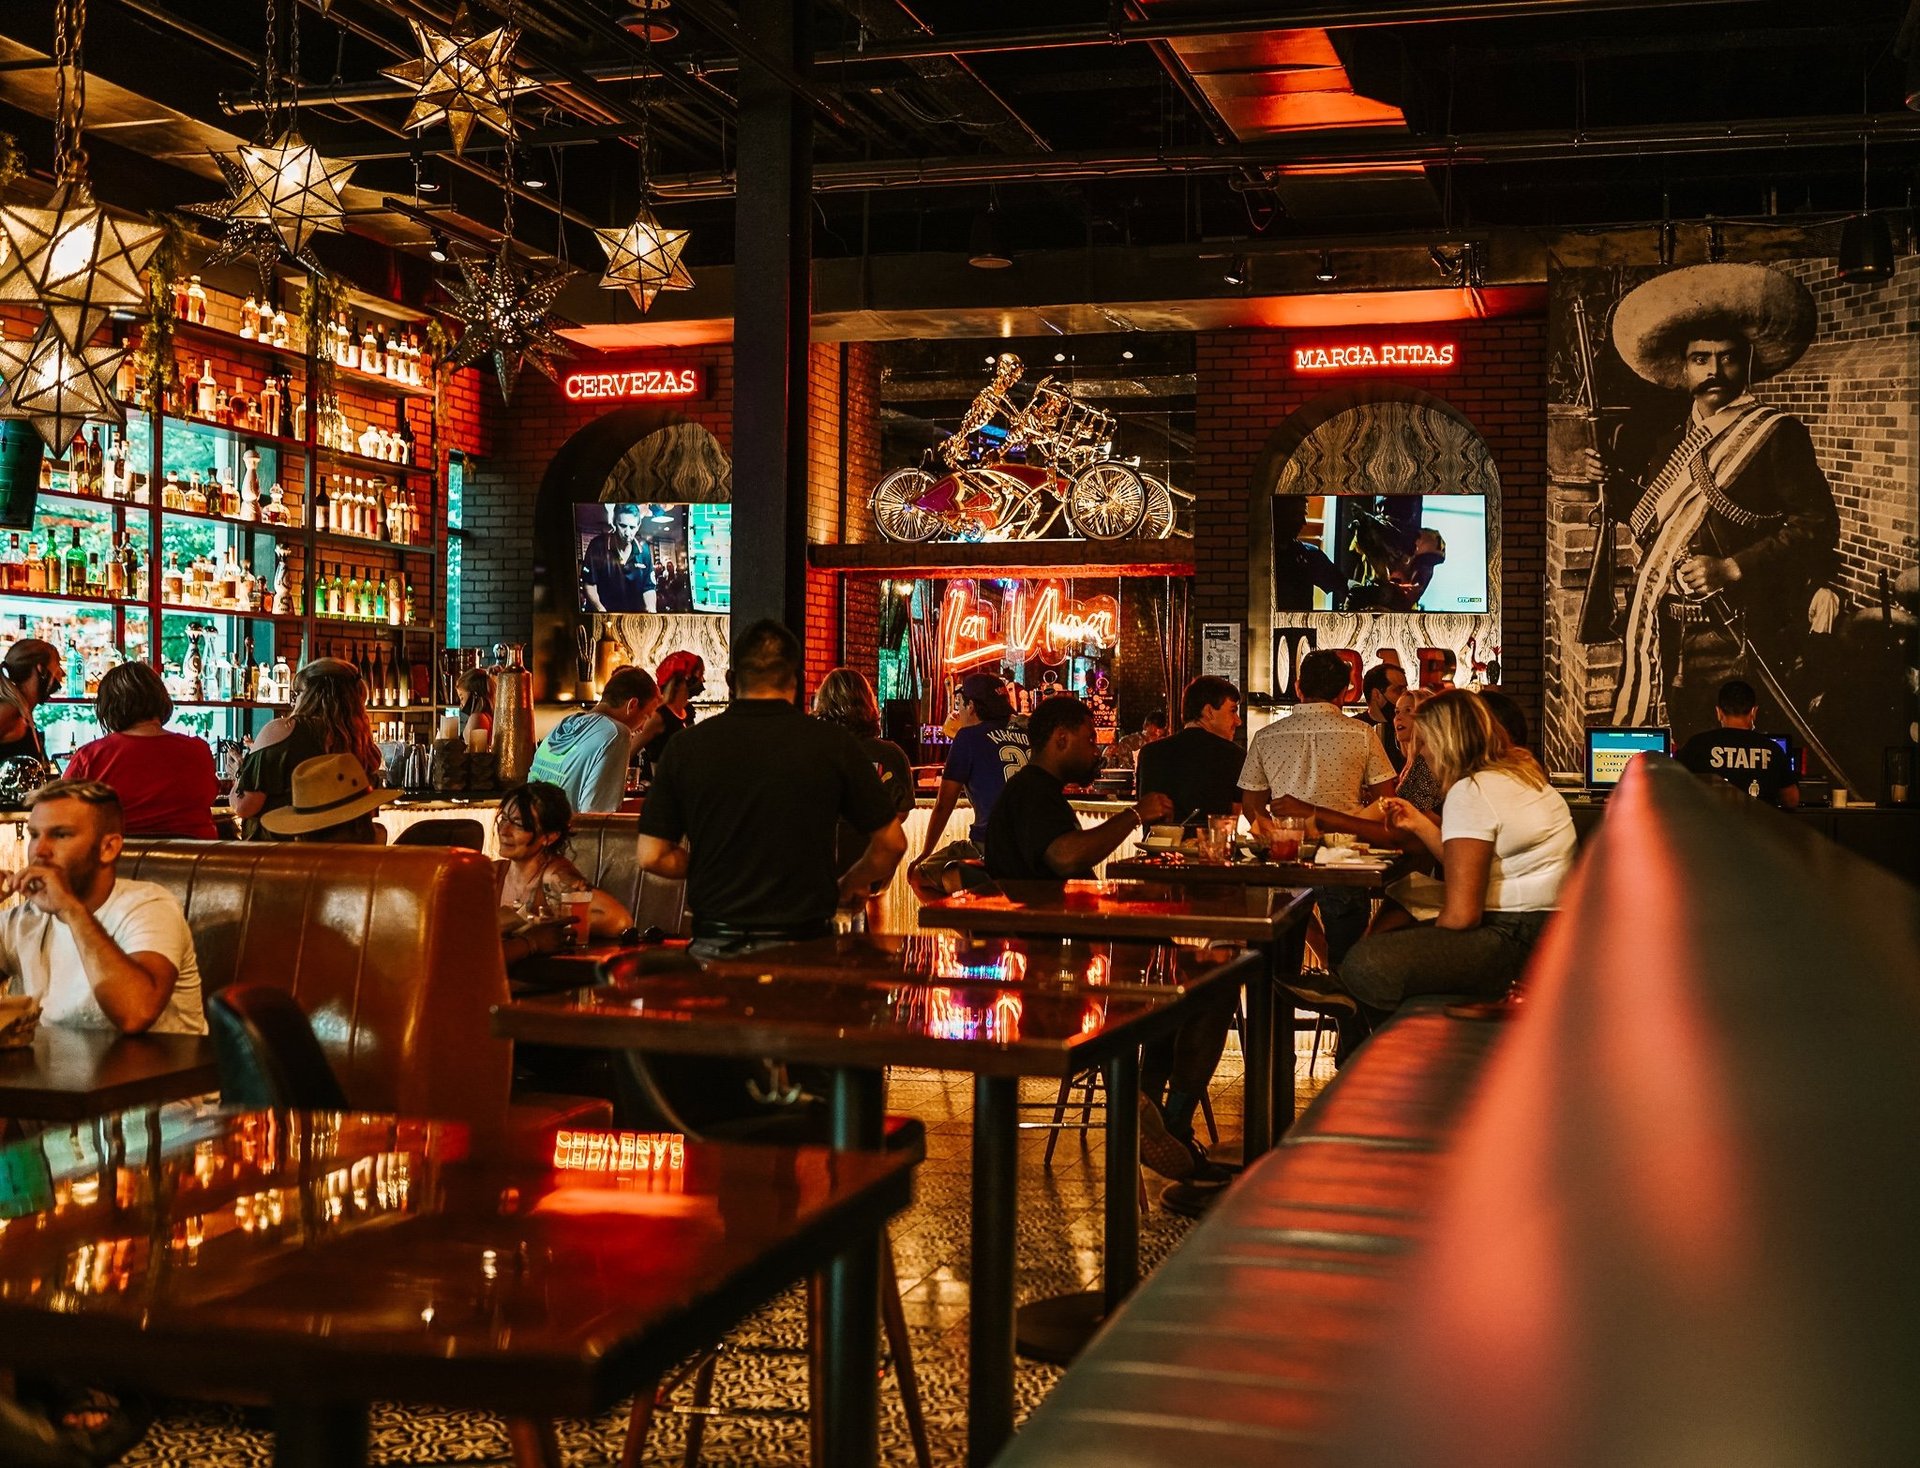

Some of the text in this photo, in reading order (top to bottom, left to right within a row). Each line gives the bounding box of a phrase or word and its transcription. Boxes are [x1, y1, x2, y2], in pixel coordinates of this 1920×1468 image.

[1295, 344, 1454, 369] MARGARITAS
[565, 369, 697, 399] CERVEZAS
[998, 744, 1032, 784] 2
[1709, 746, 1773, 770] STAFF
